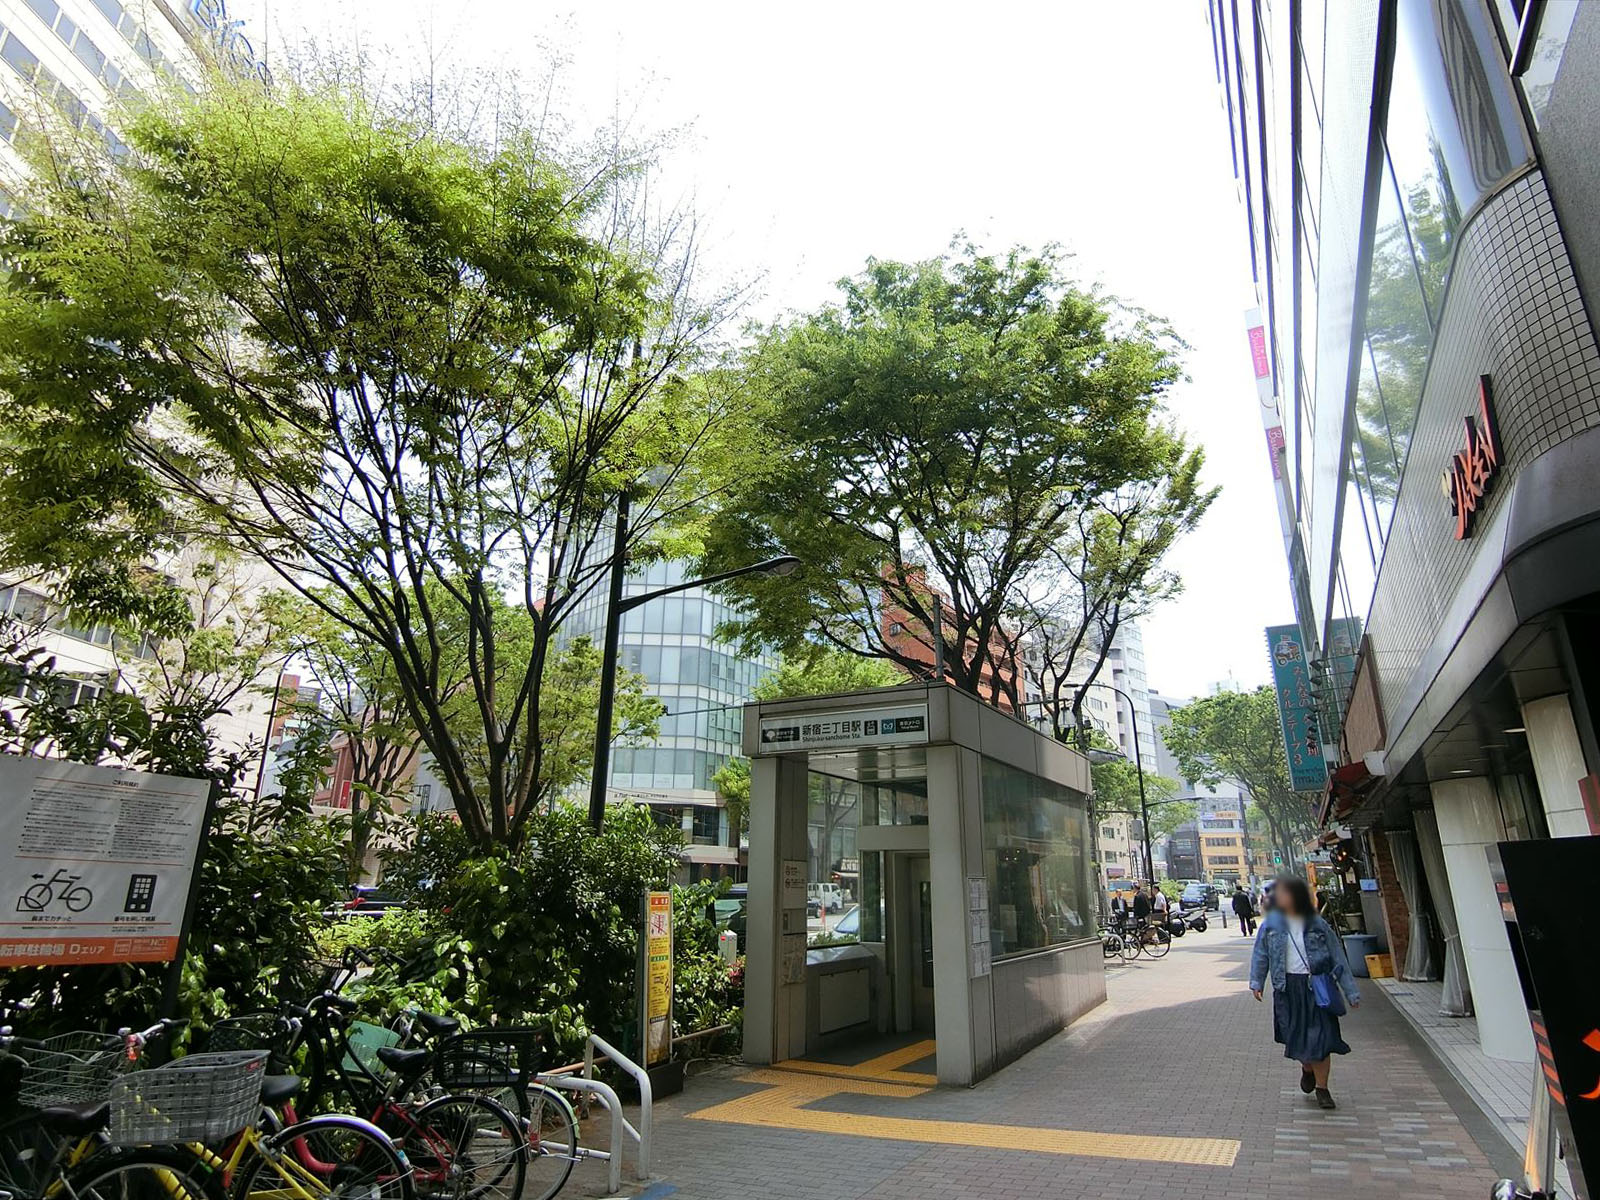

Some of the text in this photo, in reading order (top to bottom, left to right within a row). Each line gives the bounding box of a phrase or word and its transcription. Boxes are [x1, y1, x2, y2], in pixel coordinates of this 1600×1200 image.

[802, 720, 862, 736] 新宿三丁目駅
